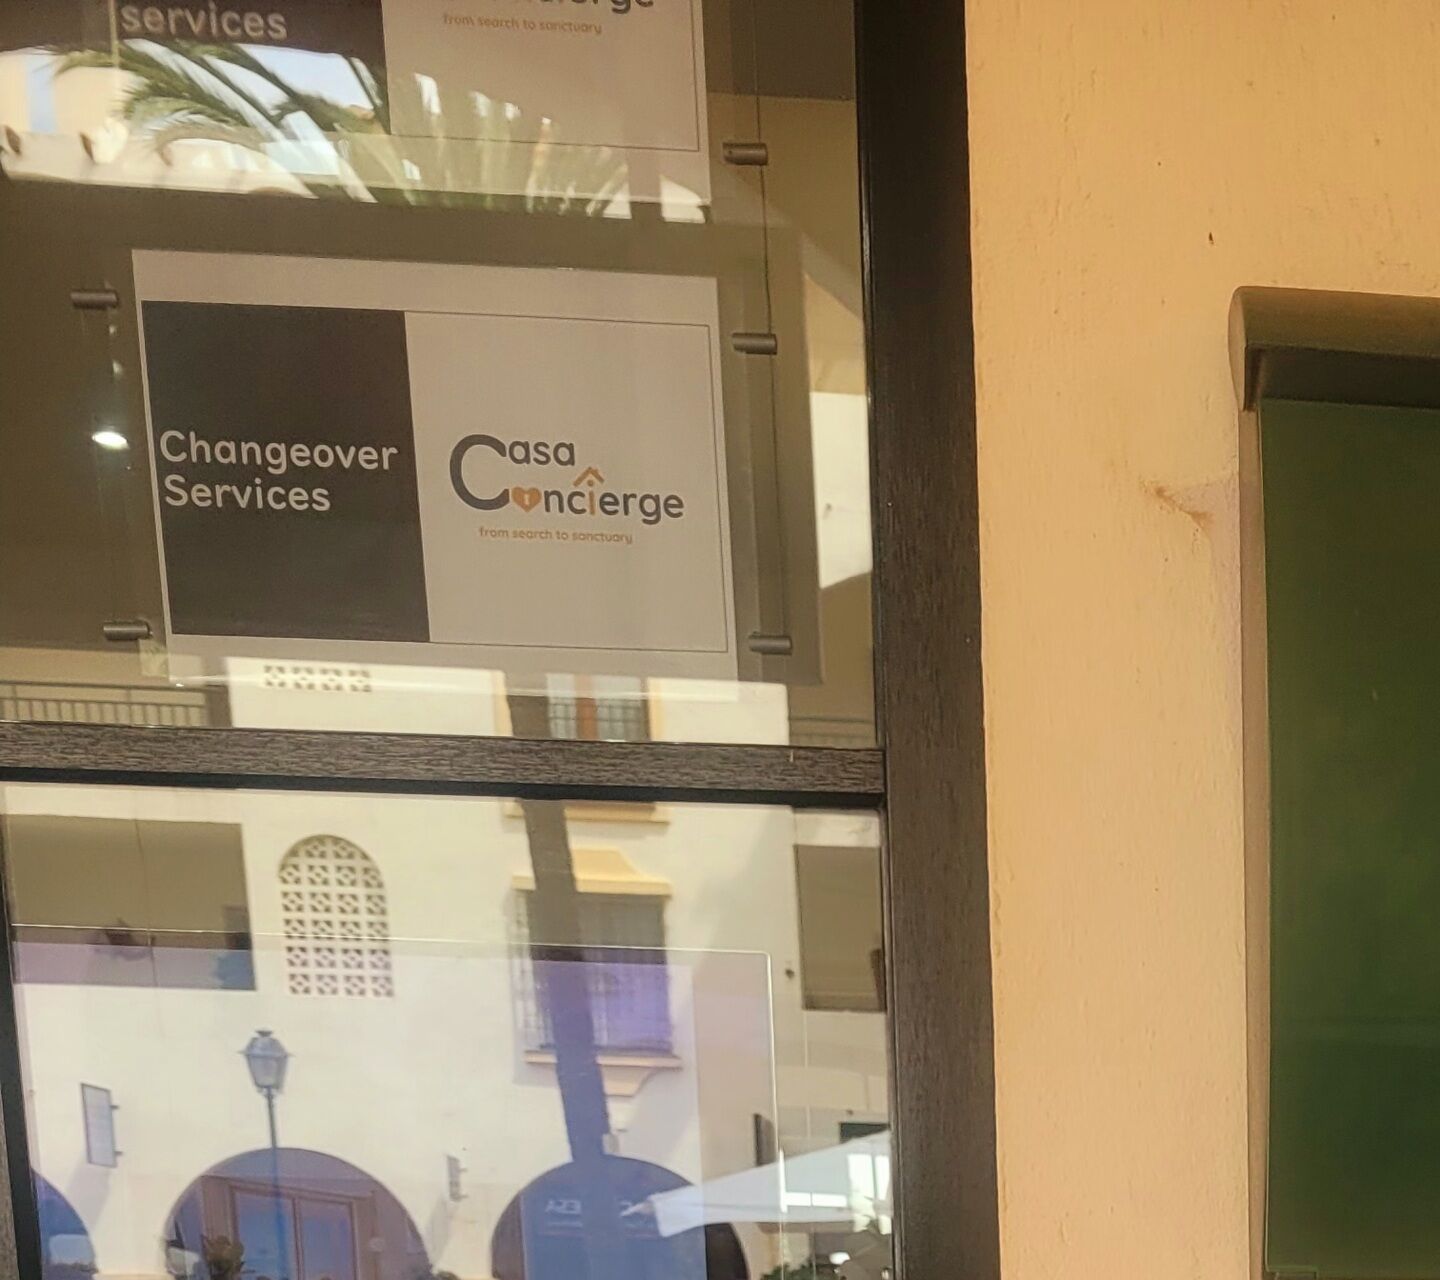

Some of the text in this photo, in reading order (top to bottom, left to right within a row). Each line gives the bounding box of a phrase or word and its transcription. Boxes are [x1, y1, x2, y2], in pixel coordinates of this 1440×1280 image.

[121, 2, 288, 40] services
[442, 13, 602, 35] from search to sanctuary
[160, 430, 398, 475] Changeover
[164, 473, 331, 511] Services
[478, 526, 633, 545] from search to sanctuary
